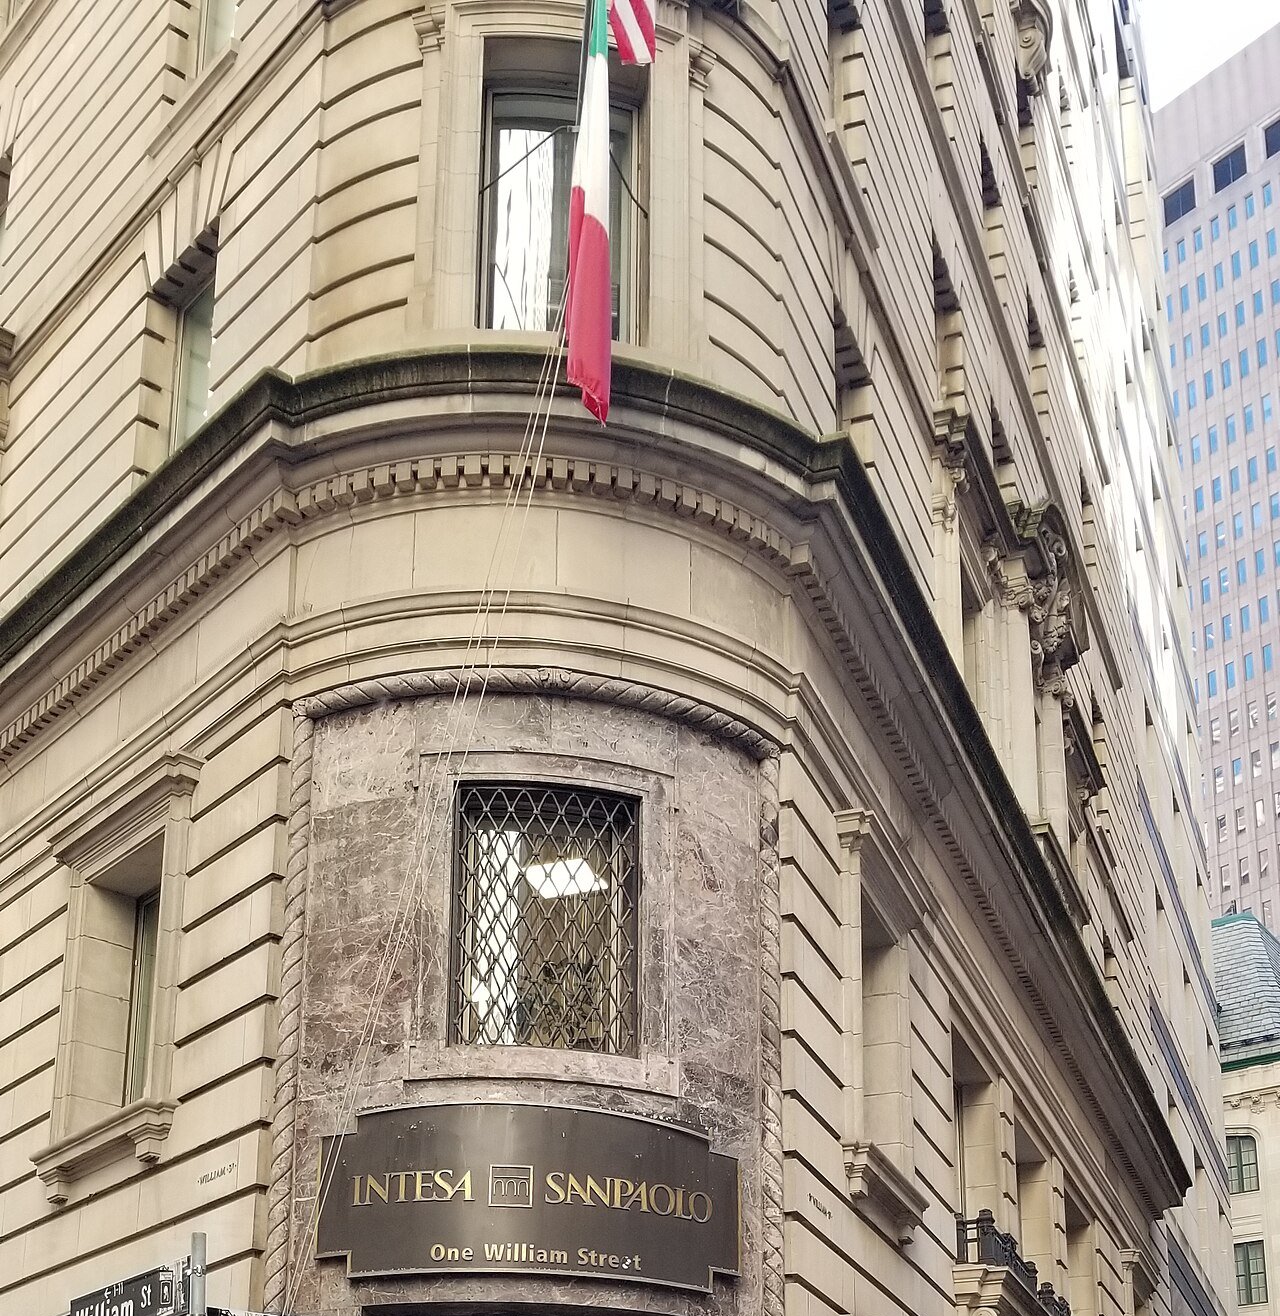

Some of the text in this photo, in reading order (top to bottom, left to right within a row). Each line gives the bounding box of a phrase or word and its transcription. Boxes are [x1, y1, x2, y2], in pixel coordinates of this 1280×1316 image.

[352, 1169, 713, 1223] INTESA SANPAOLO
[430, 1243, 474, 1262] One
[484, 1243, 568, 1264] William
[140, 1284, 152, 1309] St
